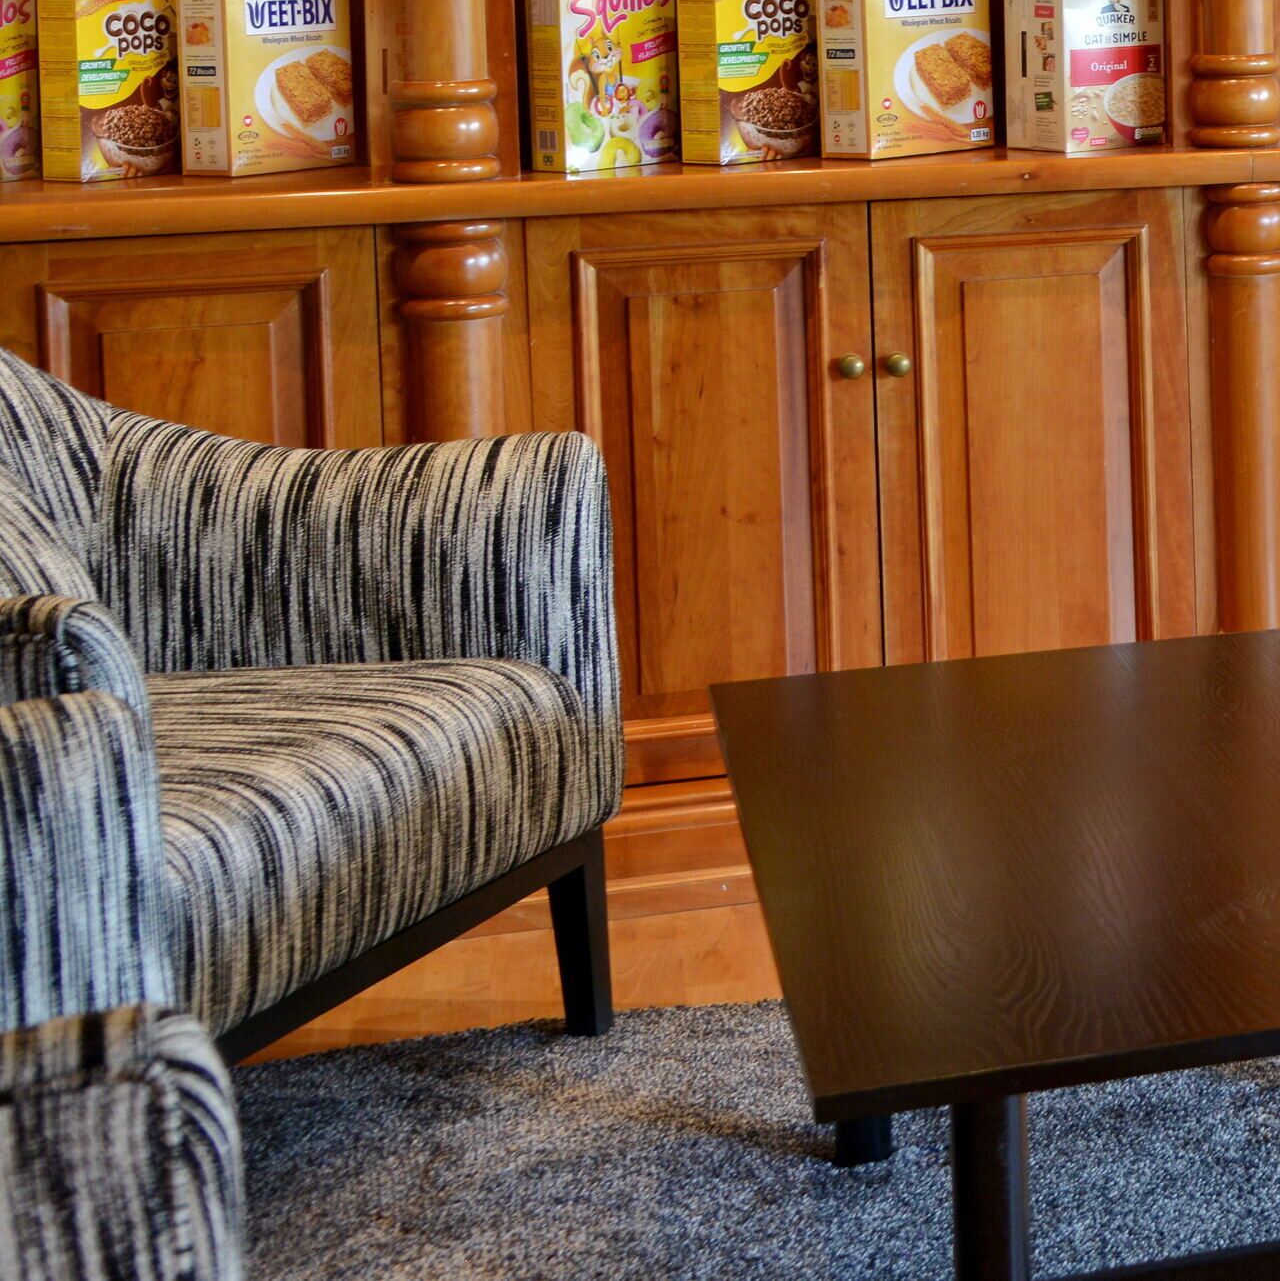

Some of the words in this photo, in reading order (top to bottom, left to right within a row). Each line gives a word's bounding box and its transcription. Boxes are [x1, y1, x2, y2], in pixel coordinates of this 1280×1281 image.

[901, 19, 928, 28] Wholegrain
[1096, 14, 1135, 26] QUAKER
[262, 36, 289, 45] Wholegrain
[1085, 34, 1103, 45] OAT
[1113, 31, 1147, 43] SIMPLE
[719, 44, 744, 53] GROWTH
[720, 55, 760, 64] DEVELOPMENT
[1150, 58, 1155, 67] 2
[81, 61, 104, 69] GROWTH
[1091, 61, 1127, 73] Original
[80, 72, 120, 81] DEVELOPMENT
